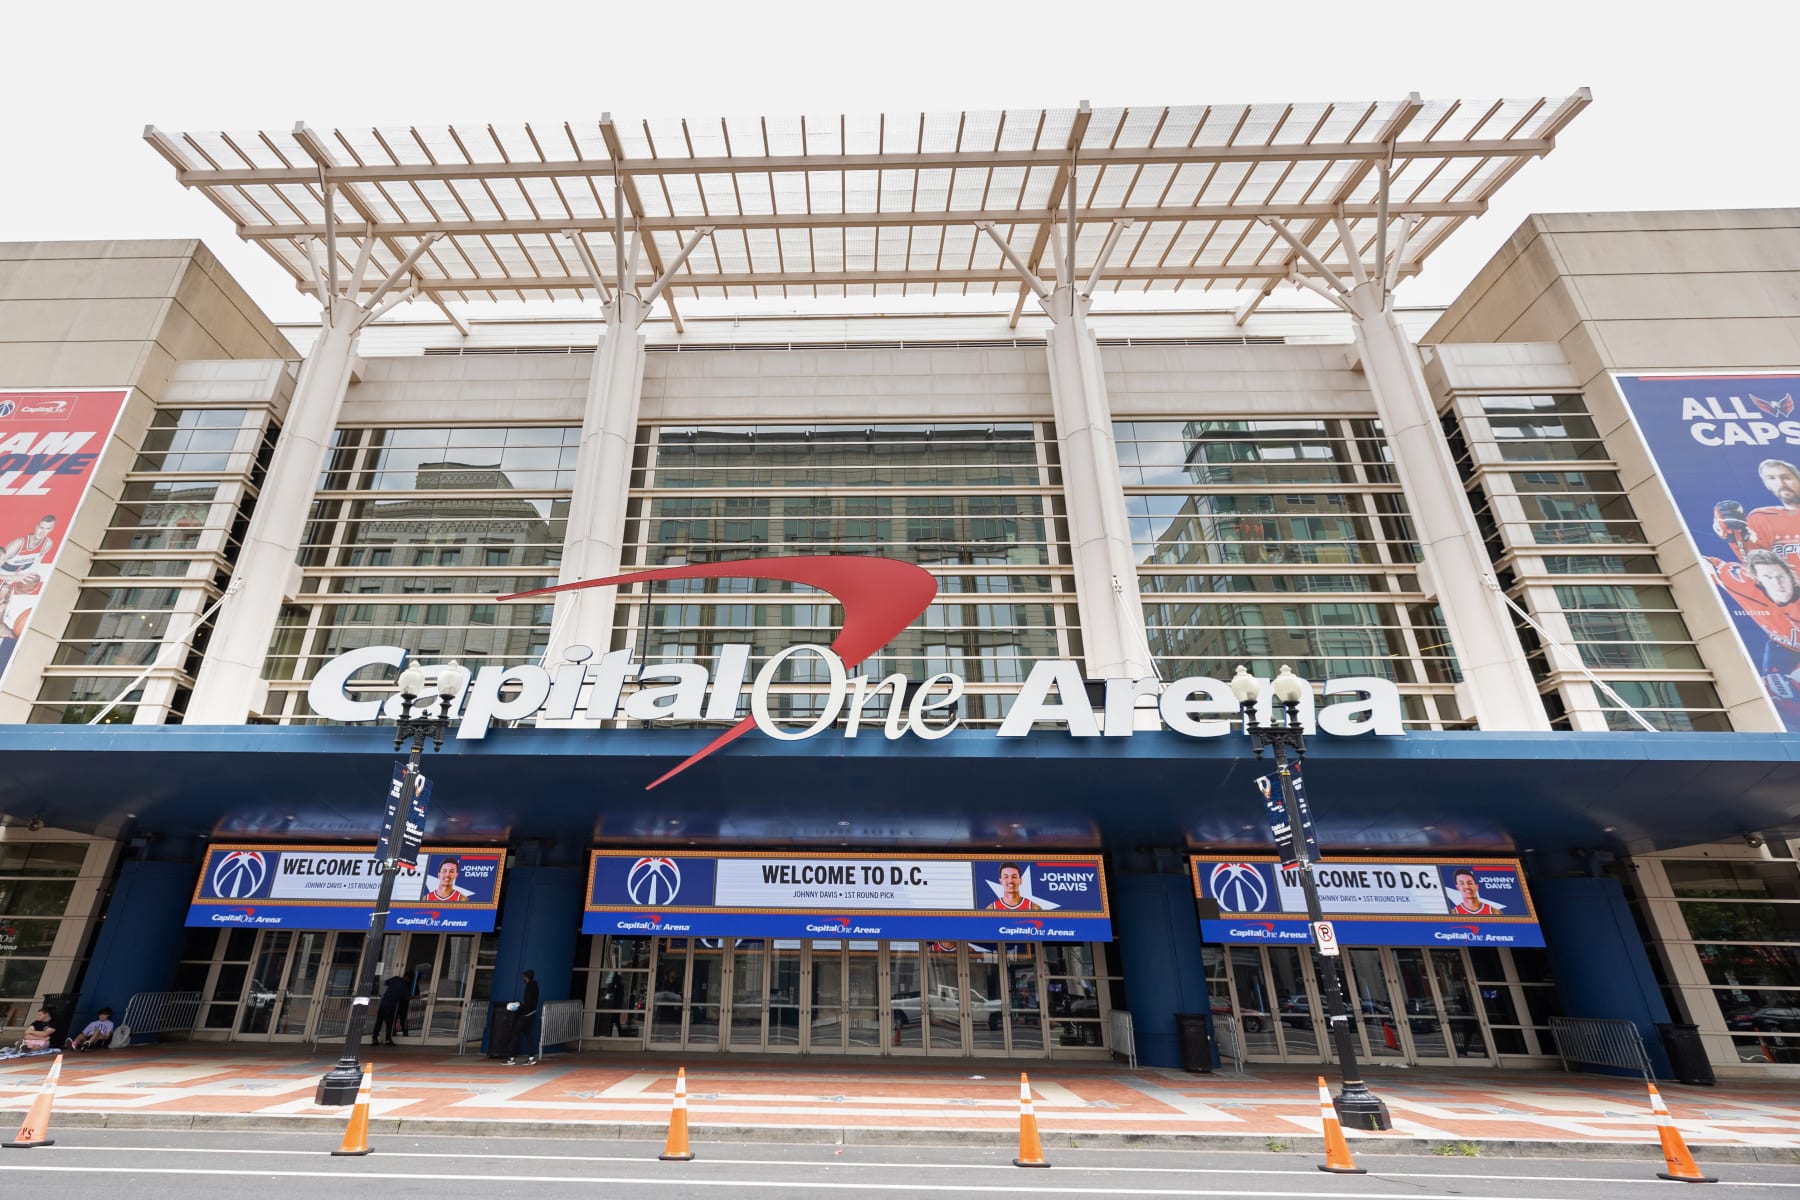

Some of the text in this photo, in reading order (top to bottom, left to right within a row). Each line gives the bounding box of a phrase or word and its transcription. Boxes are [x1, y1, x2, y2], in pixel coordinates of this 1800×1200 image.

[1682, 396, 1763, 420] ALL
[1691, 420, 1800, 447] CAPS
[0, 431, 96, 456] AM
[996, 660, 1407, 737] Arena
[283, 858, 363, 876] WELCOME
[367, 860, 386, 877] TO
[762, 865, 928, 886] WELCOME TO D.C.
[1040, 872, 1094, 882] JOHNNY
[1373, 871, 1396, 889] TO
[1400, 871, 1438, 889] D.C.
[304, 881, 326, 889] JOHNNY
[1049, 882, 1088, 891] DAVIS
[819, 891, 838, 899] DAVIS
[844, 891, 856, 899] 1ST
[856, 891, 879, 899] ROUND
[880, 891, 895, 899] PICK
[255, 916, 281, 924] Arena
[441, 919, 468, 927] Arena
[663, 923, 690, 931] Arena
[853, 926, 881, 934] Arena
[1047, 928, 1075, 936] Arena
[1279, 931, 1307, 939] Arena
[1485, 933, 1514, 942] Arena
